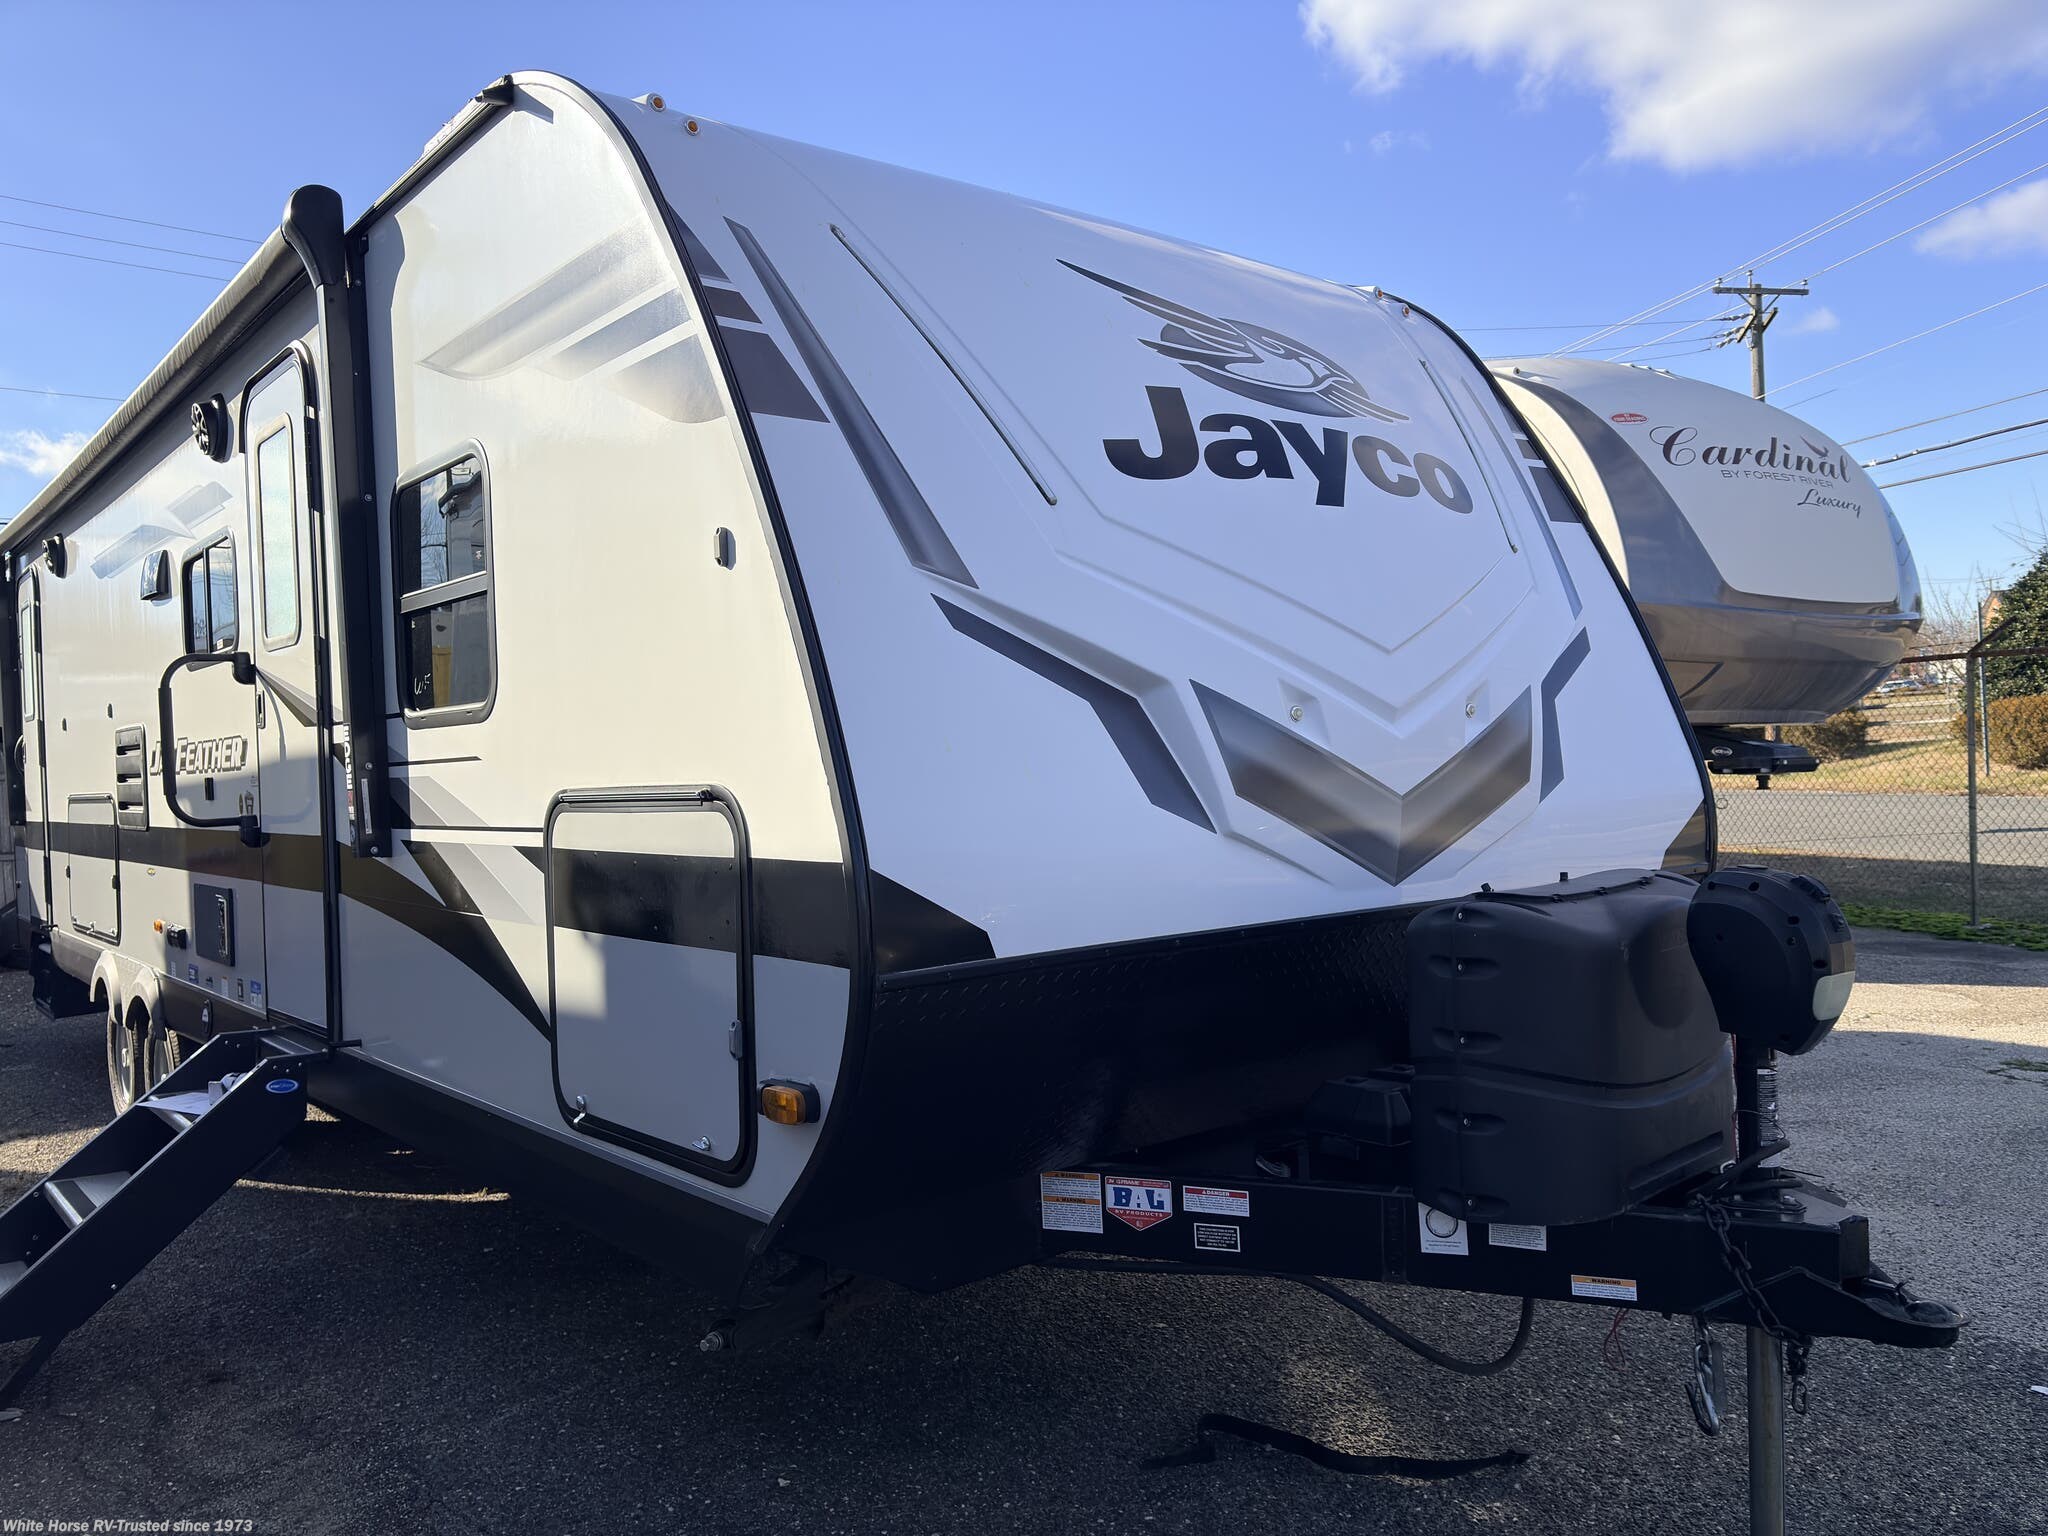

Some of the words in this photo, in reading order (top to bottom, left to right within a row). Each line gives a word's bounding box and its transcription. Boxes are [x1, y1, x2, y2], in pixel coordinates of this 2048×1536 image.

[1102, 385, 1473, 514] Jayco
[1650, 426, 1850, 483] Cardinal
[1721, 469, 1739, 478] BY
[1744, 471, 1796, 482] FOREST
[1799, 475, 1834, 488] RIVER
[1797, 488, 1862, 518] Luxury
[1112, 1186, 1165, 1210] BAL
[1592, 1278, 1622, 1286] WARNING
